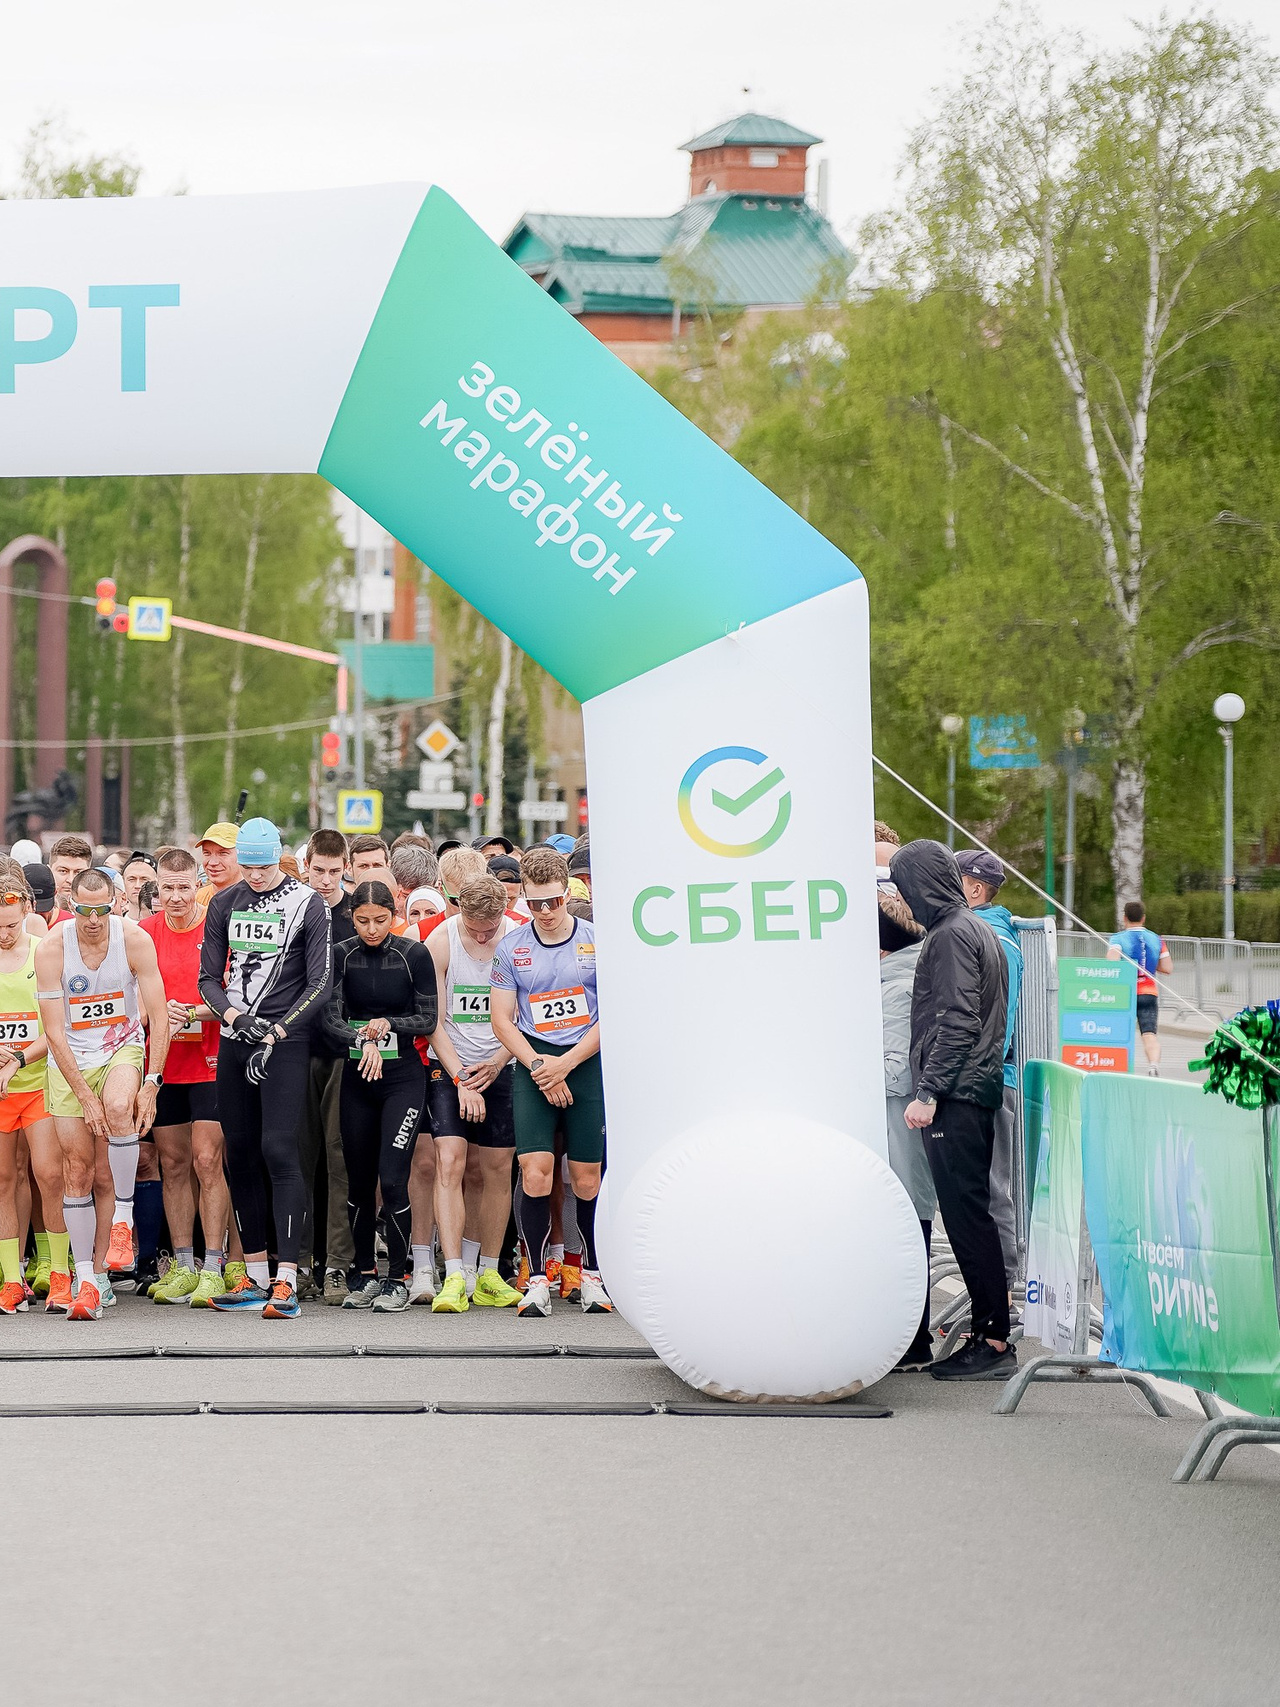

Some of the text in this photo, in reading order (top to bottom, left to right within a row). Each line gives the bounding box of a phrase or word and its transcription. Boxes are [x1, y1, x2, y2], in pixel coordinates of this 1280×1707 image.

[457, 360, 684, 557] зелёный
[418, 398, 638, 596] марафон
[632, 879, 848, 947] СБЕР
[234, 922, 273, 940] 1154
[1075, 967, 1121, 978] ТРАНЗИТ
[81, 1002, 115, 1019] 238
[459, 996, 490, 1011] 141
[542, 999, 577, 1019] 233
[1141, 1234, 1185, 1271] твоём
